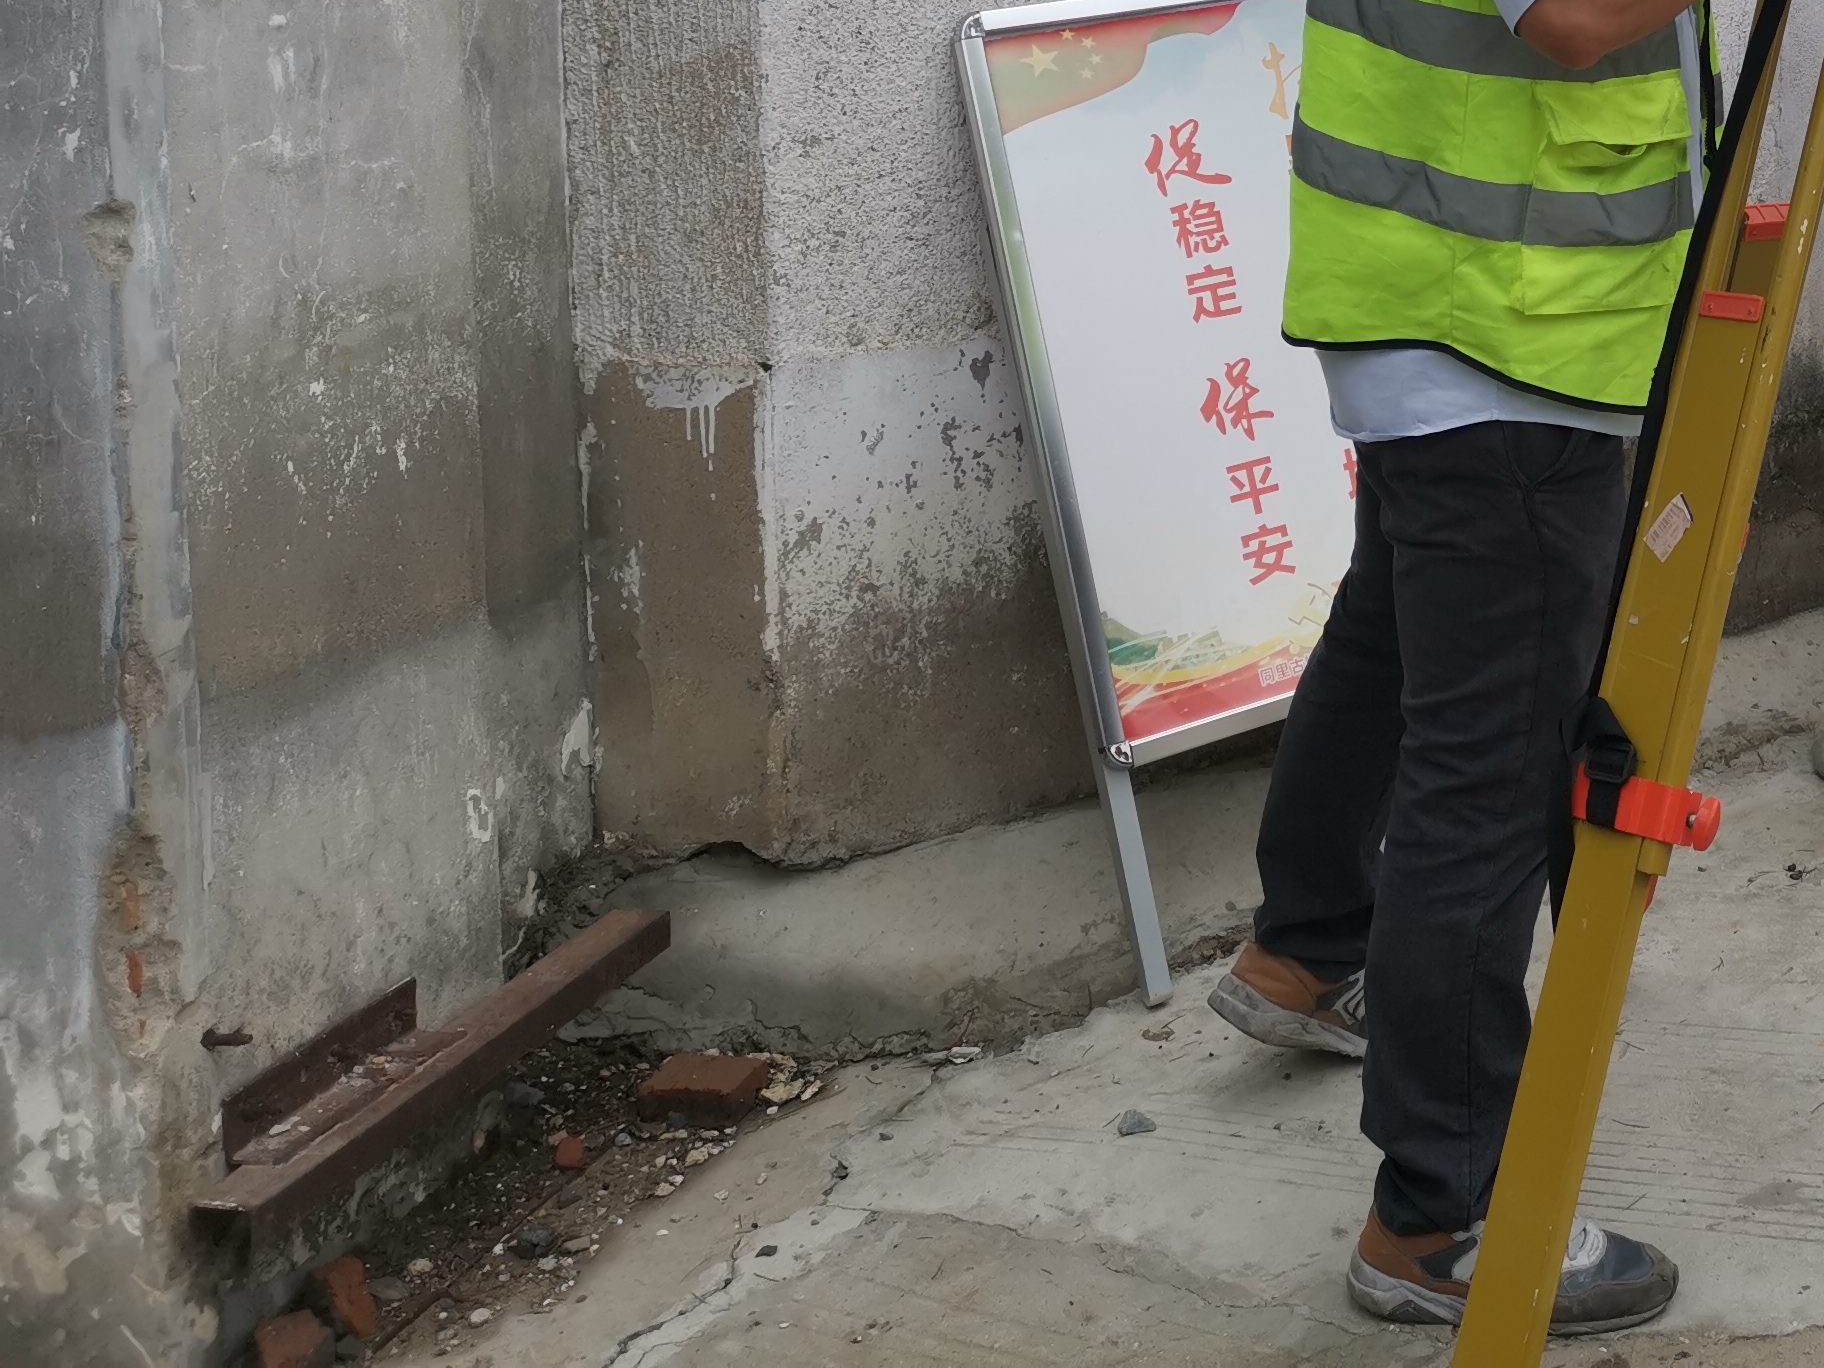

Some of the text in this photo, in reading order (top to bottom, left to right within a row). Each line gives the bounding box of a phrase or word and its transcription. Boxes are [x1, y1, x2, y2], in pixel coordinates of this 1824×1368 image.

[1144, 118, 1297, 586] 促稳定 保平安
[1260, 656, 1308, 685] 同里古
